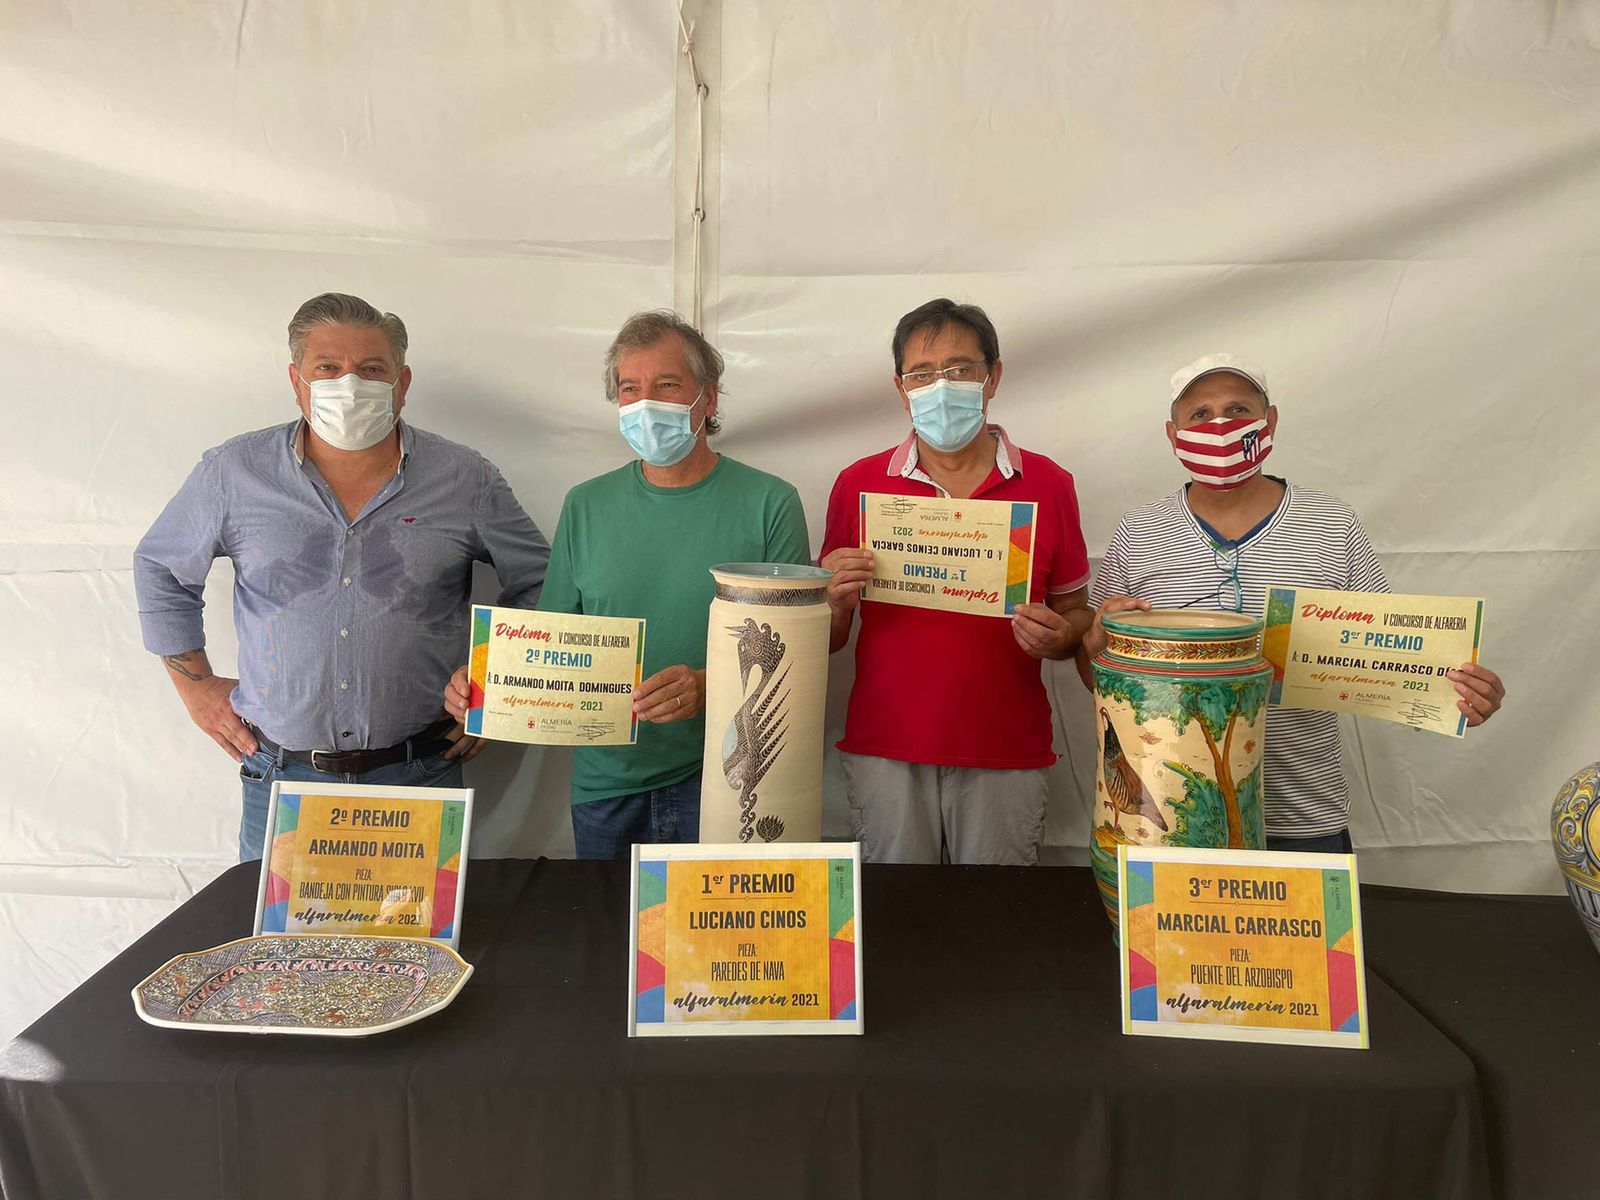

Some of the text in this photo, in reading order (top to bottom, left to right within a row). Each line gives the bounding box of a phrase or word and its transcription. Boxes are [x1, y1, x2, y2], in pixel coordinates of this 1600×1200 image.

[893, 527, 913, 536] 2021
[872, 540, 904, 551] GARCÍA
[907, 544, 938, 555] CEINOS
[942, 547, 980, 557] LUCIANO
[984, 549, 992, 558] D.
[904, 564, 947, 579] PREMIO
[898, 581, 904, 589] DE
[905, 581, 930, 592] CONCURSO
[931, 584, 935, 593] V
[941, 586, 999, 604] Diploma
[1302, 604, 1375, 624] Diploma
[1383, 613, 1389, 625] V
[1390, 613, 1423, 628] CONCURSO
[1425, 616, 1433, 628] DE
[495, 623, 552, 643] Diploma
[559, 632, 563, 644] V
[564, 632, 591, 646] CONCURSO
[593, 634, 600, 646] DE
[1365, 632, 1423, 651] PREMIO
[544, 651, 592, 668] PREMIO
[1302, 653, 1312, 664] D.
[1317, 655, 1367, 669] MARCIAL
[1372, 661, 1432, 676] CARRASCO
[494, 674, 501, 685] D.
[503, 675, 544, 689] ARMANDO
[546, 680, 574, 691] MOITA
[579, 681, 632, 694] DOMINGUES
[1403, 680, 1430, 692] 2021
[581, 701, 603, 711] 2021
[541, 718, 572, 726] ALMERÍA
[352, 809, 410, 828] PREMIO
[309, 839, 424, 859] ARMANDO MOITA
[355, 868, 373, 881] PIEZA:
[730, 873, 795, 893] PREMIO
[1218, 878, 1287, 901] PREMIO
[300, 882, 333, 900] BANDEJA
[336, 883, 351, 900] CON
[353, 884, 384, 901] PINTURA
[690, 910, 806, 930] LUCIANO CINOS
[1158, 913, 1322, 938] MARCIAL CARRASCO
[738, 944, 758, 956] PIEZA:
[1230, 948, 1251, 962] PIEZA:
[711, 961, 784, 982] PAREDES DE NAVA
[1191, 964, 1293, 989] PUENTE DEL ARZOBISPO
[792, 993, 819, 1006] 2021
[1290, 1002, 1319, 1016] 2021
